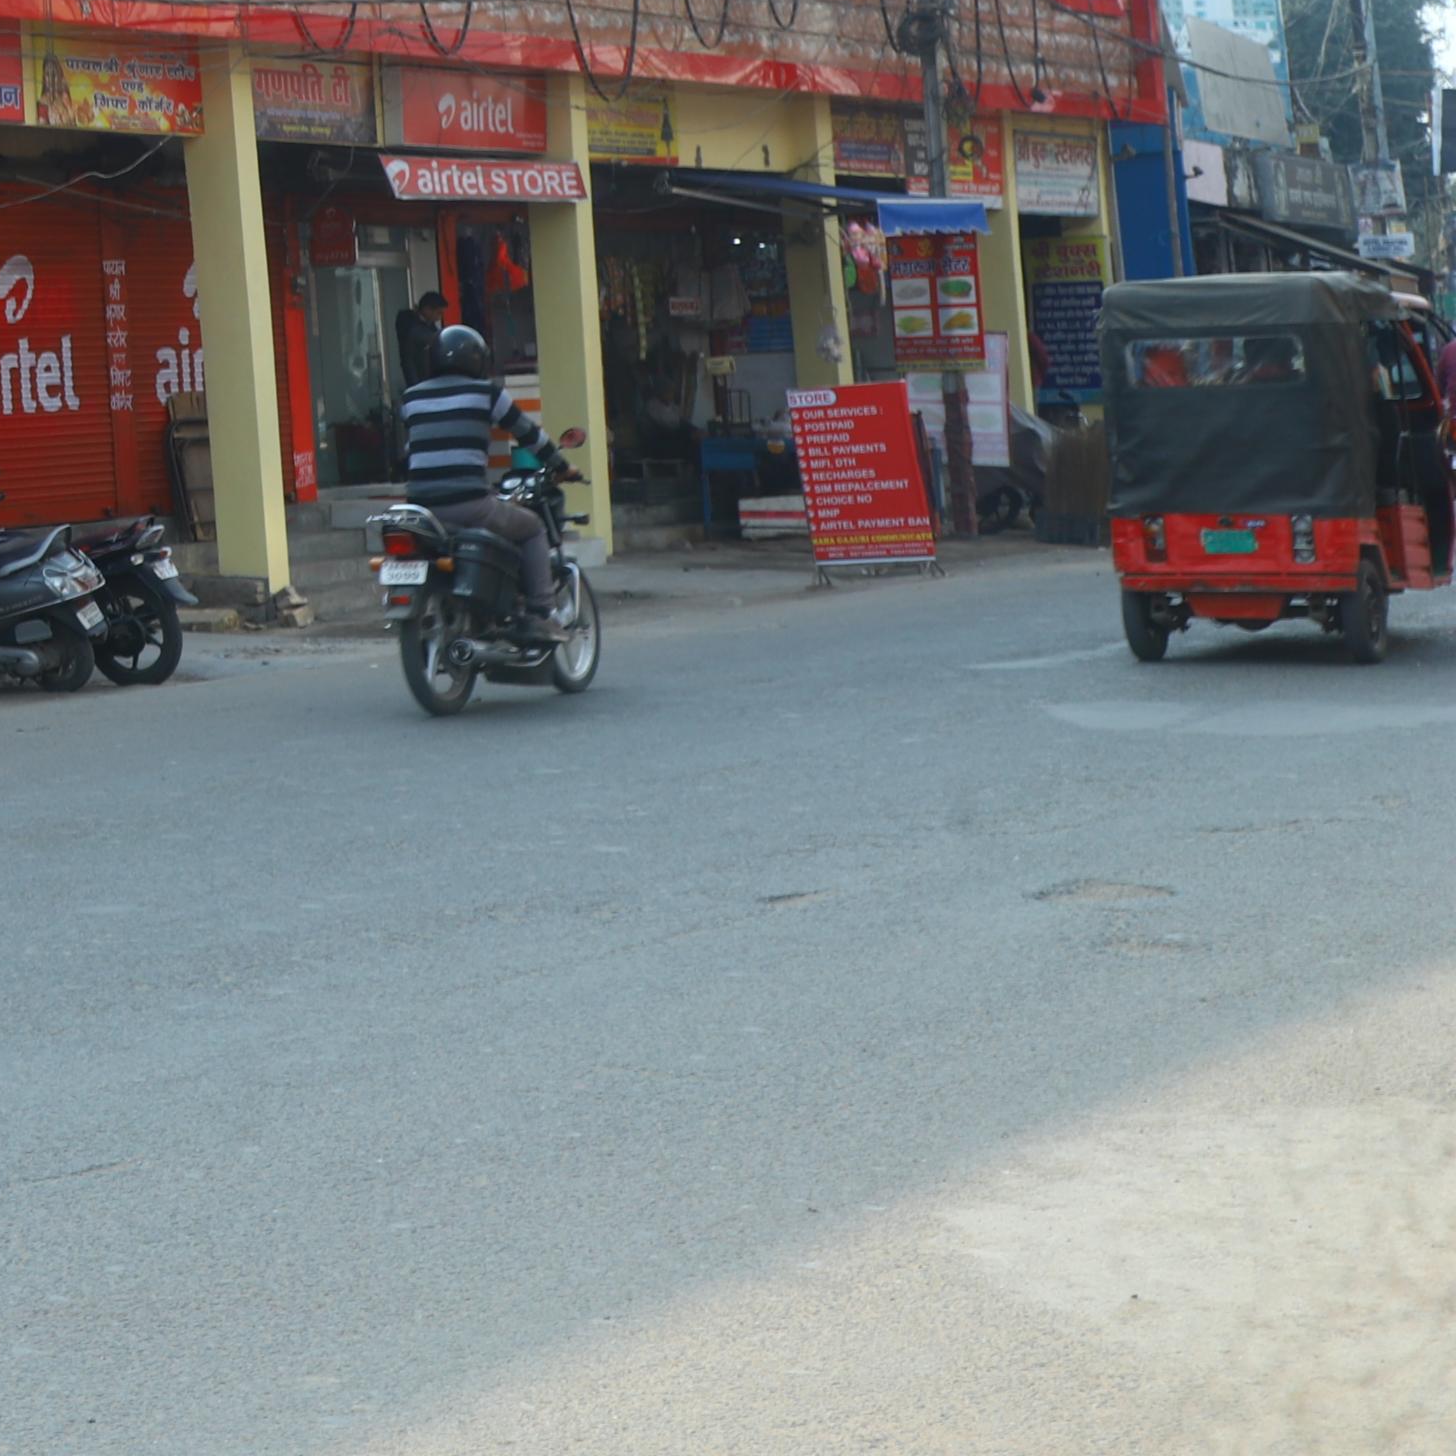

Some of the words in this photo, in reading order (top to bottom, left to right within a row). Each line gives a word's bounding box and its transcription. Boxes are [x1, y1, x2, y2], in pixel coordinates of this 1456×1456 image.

[460, 90, 514, 133] airtel
[417, 159, 488, 195] airtel
[490, 169, 581, 195] STORE
[156, 327, 204, 406] air
[789, 391, 831, 405] STORE
[802, 409, 825, 419] OUR
[827, 405, 878, 419] SERVICES
[804, 420, 854, 432] POSTPAID
[806, 433, 850, 445] PREPAID
[808, 446, 831, 458] BILL
[832, 443, 887, 455] PAYMENTS
[836, 457, 856, 467] DTH
[812, 469, 876, 481] RECHARGES
[814, 482, 832, 493] SIM
[834, 479, 909, 492] REPALCEMENT
[816, 495, 855, 506] CHOICE
[857, 494, 873, 504] NO
[817, 509, 840, 519] MNP
[820, 519, 855, 531] AIRTEL
[858, 517, 905, 529] PAYMENT
